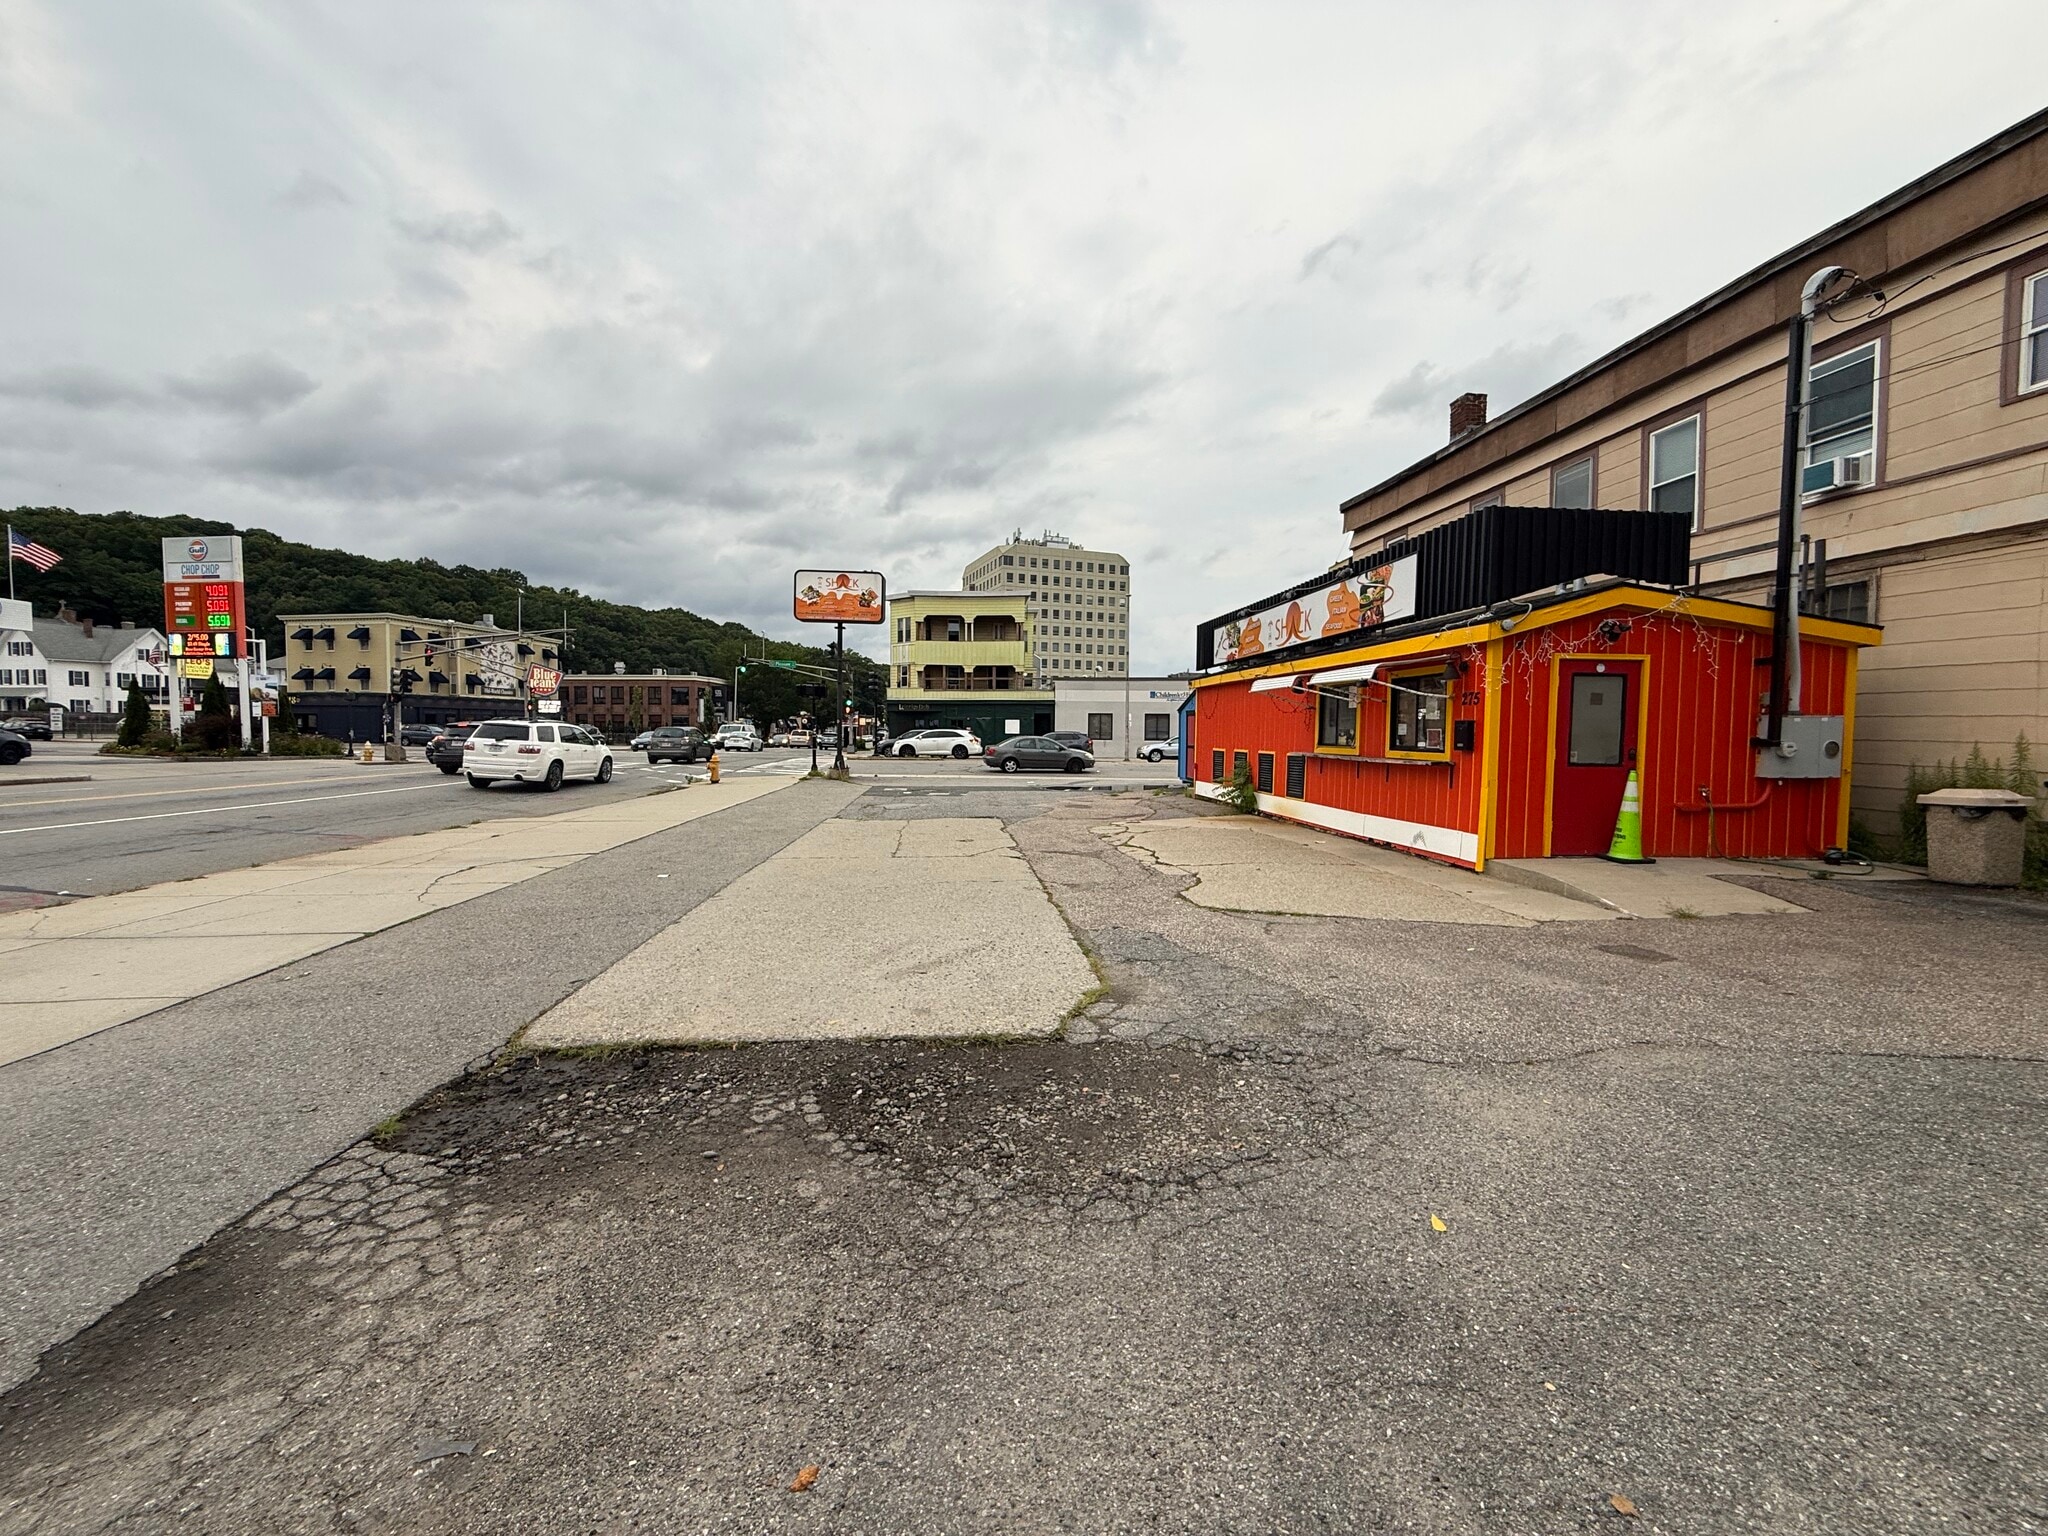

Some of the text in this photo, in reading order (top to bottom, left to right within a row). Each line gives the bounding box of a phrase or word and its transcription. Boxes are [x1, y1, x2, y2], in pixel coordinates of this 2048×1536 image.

[188, 546, 205, 554] Gulf
[181, 563, 220, 575] CHOP CHOP
[533, 668, 557, 680] Blue
[530, 678, 556, 688] Jeans
[1461, 691, 1481, 706] 275
